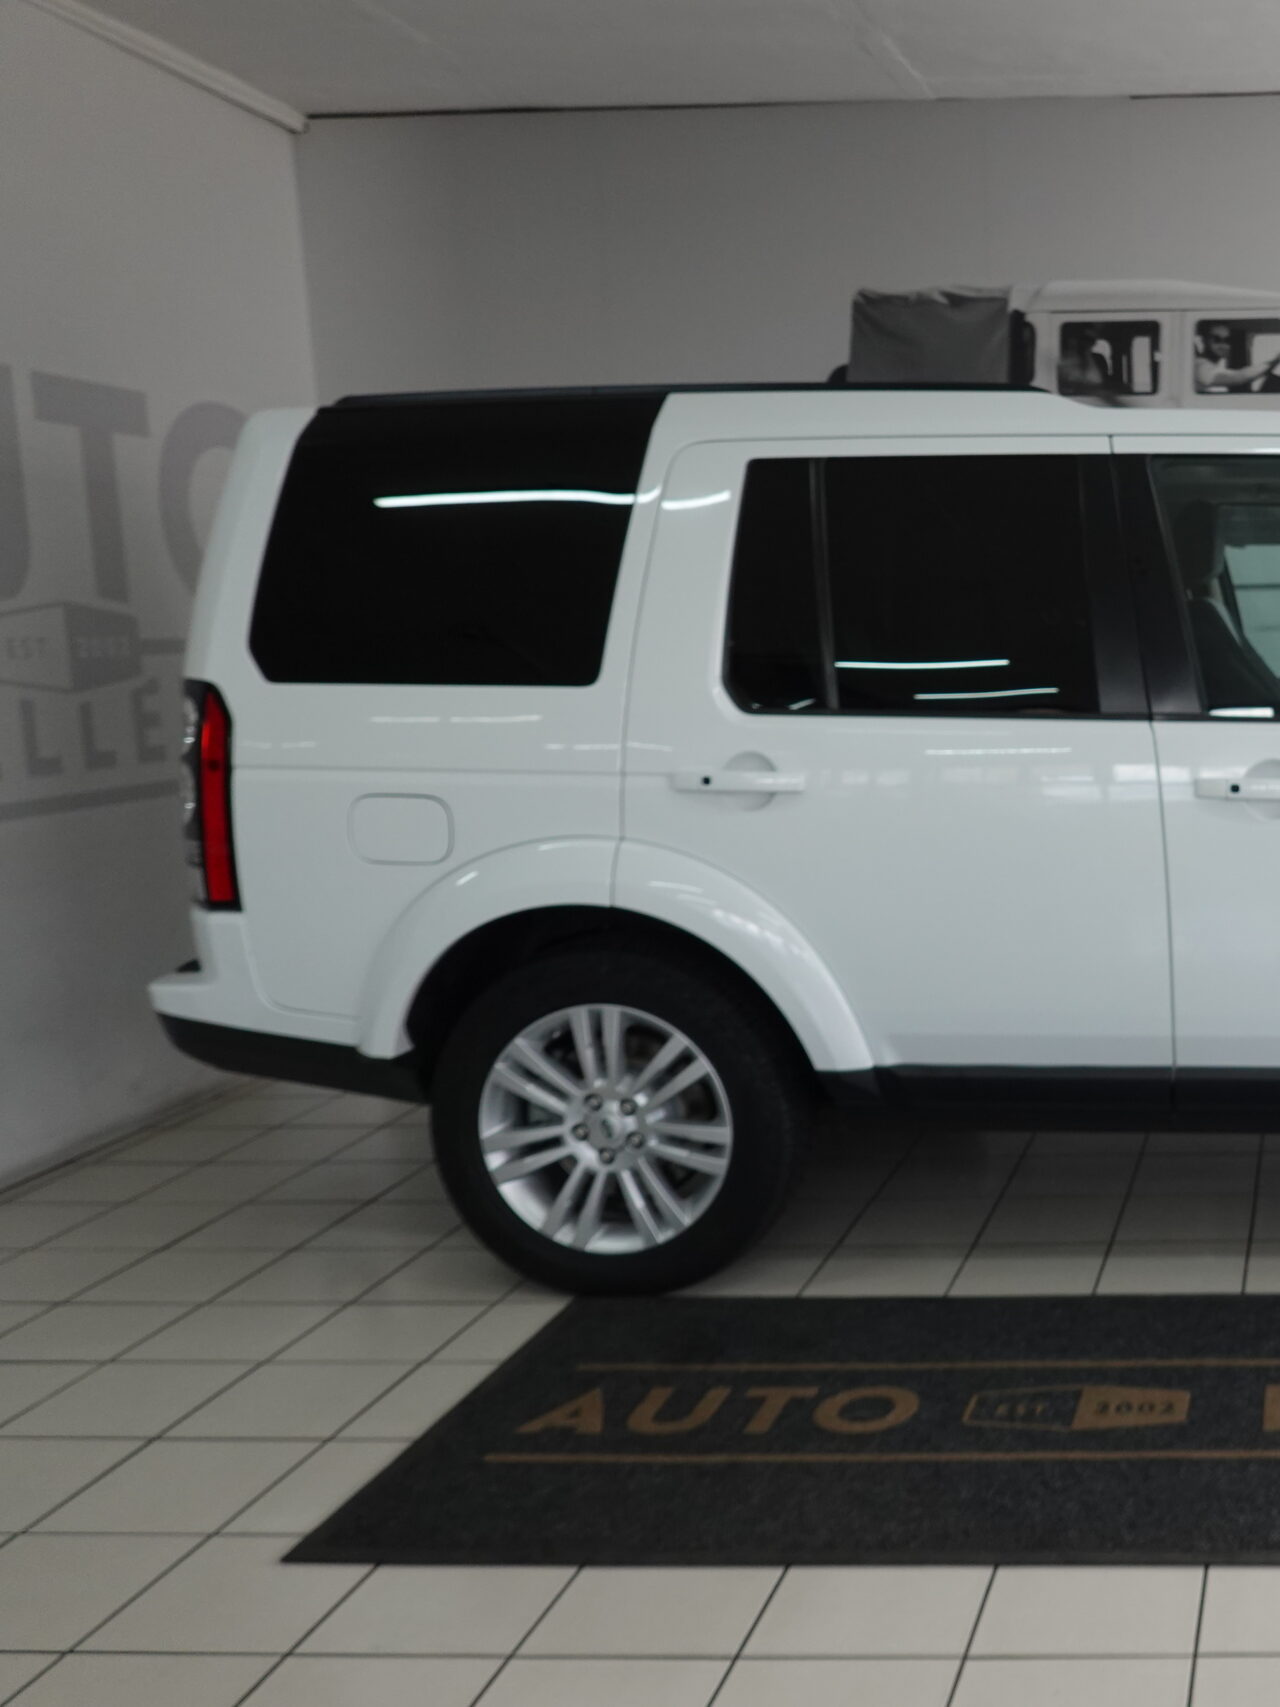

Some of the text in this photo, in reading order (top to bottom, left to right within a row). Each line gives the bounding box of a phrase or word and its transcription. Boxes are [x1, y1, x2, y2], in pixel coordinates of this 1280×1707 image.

[0, 678, 168, 777] LLE
[514, 1386, 919, 1435] AUTO
[1094, 1400, 1176, 1416] 2002
